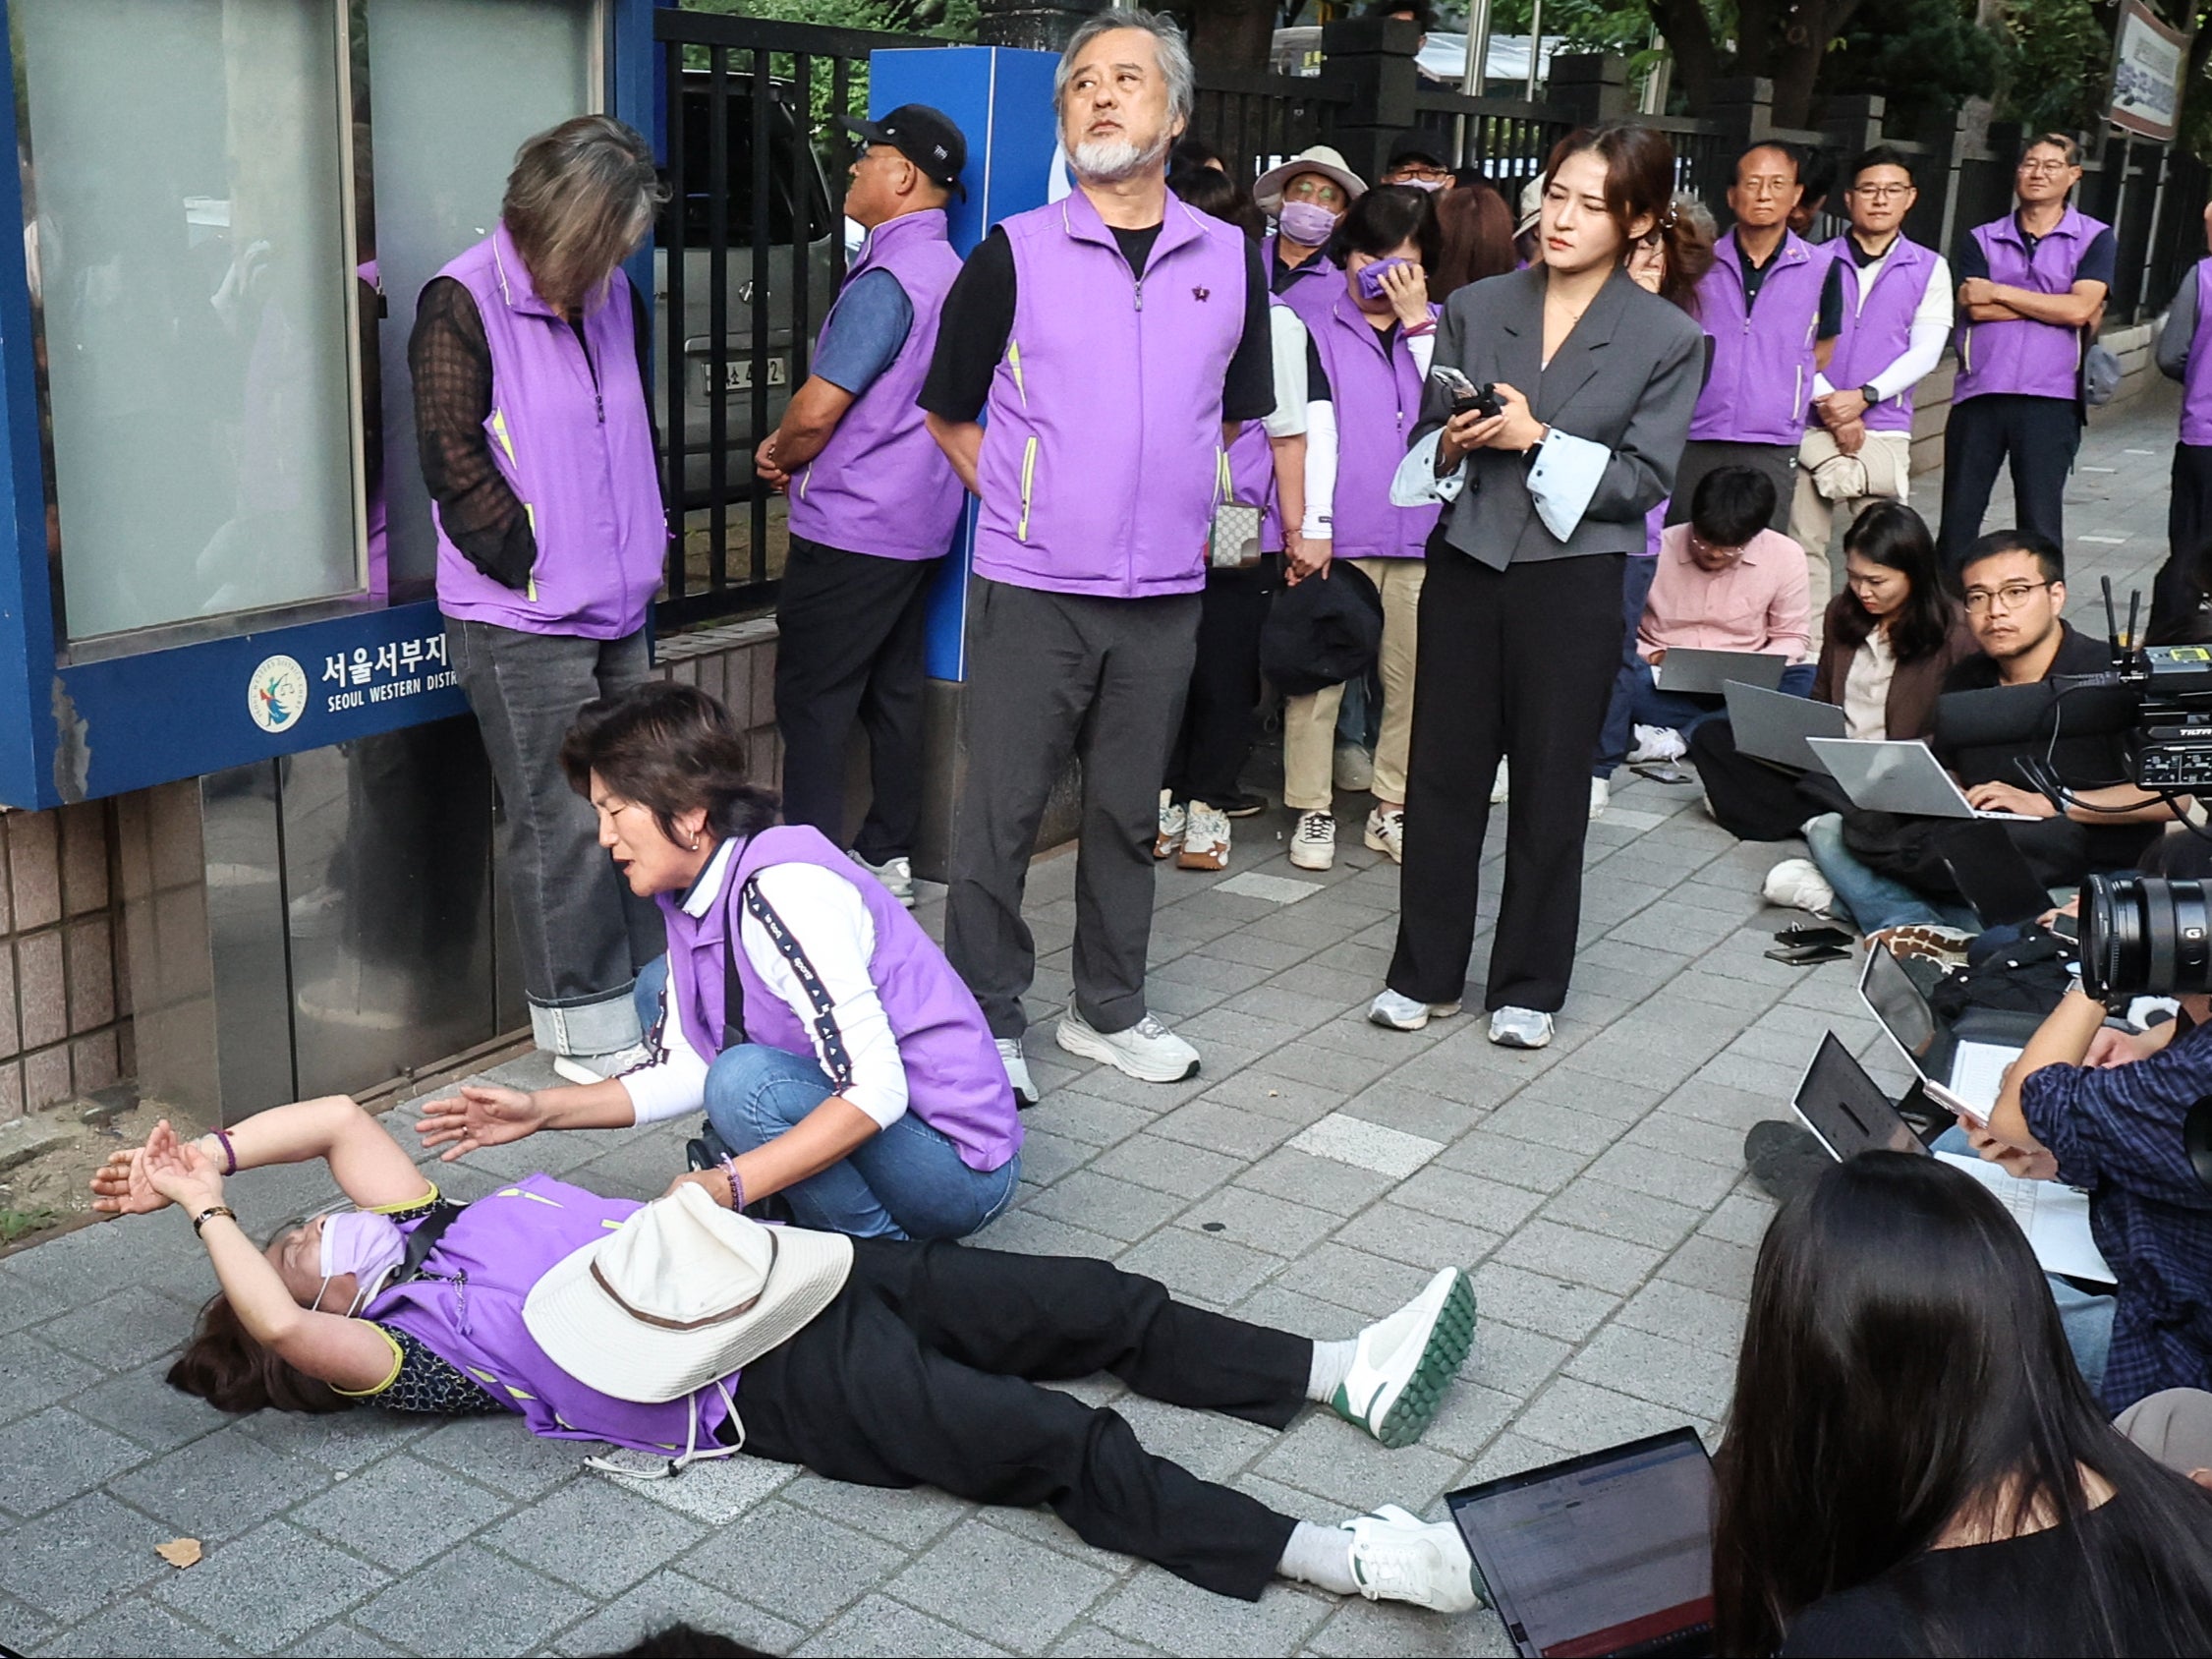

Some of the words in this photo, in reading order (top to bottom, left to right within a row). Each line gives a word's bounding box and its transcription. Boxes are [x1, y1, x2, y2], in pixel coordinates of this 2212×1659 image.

[322, 633, 447, 687] 서울서부지
[327, 692, 365, 712] SEOUL
[369, 678, 421, 703] WESTERN
[2185, 929, 2201, 939] G
